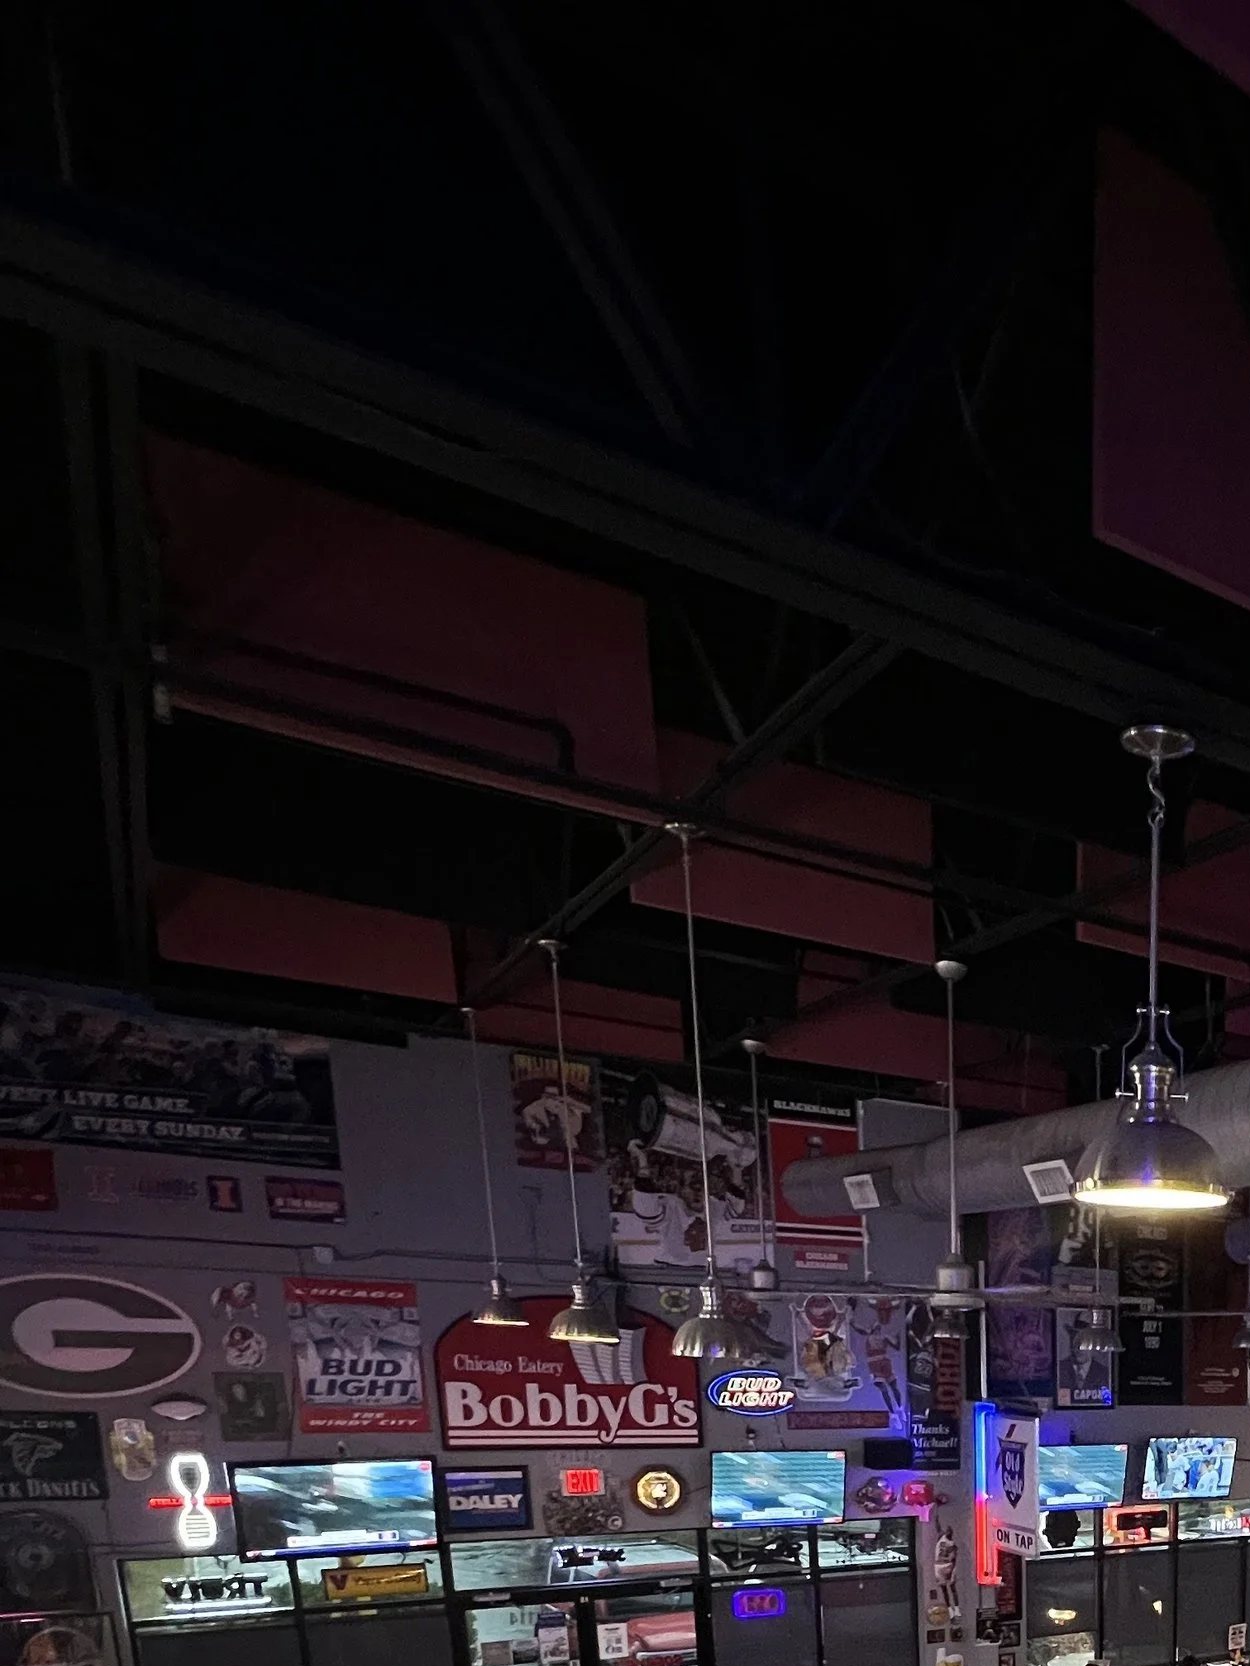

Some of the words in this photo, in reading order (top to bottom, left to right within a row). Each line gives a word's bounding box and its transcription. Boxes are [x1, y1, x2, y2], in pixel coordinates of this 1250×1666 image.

[64, 1089, 119, 1108] LIVE
[773, 1100, 851, 1117] BLACKHAWKS
[72, 1115, 149, 1135] EVERY
[294, 1287, 404, 1300] CHICAGO
[321, 1358, 402, 1377] BUD
[453, 1353, 511, 1373] Chicago
[518, 1355, 565, 1377] Eatery
[306, 1378, 418, 1398] LIGHT
[727, 1377, 782, 1393] BUD
[719, 1392, 794, 1407] LIGHT
[308, 1419, 376, 1428] WINDY
[380, 1418, 418, 1427] CITY
[352, 1411, 383, 1420] THE
[912, 1424, 950, 1435] Thanks
[568, 1470, 599, 1493] EXIT
[449, 1493, 523, 1511] DALEY
[997, 1528, 1010, 1545] ON
[1014, 1532, 1033, 1550] TAP
